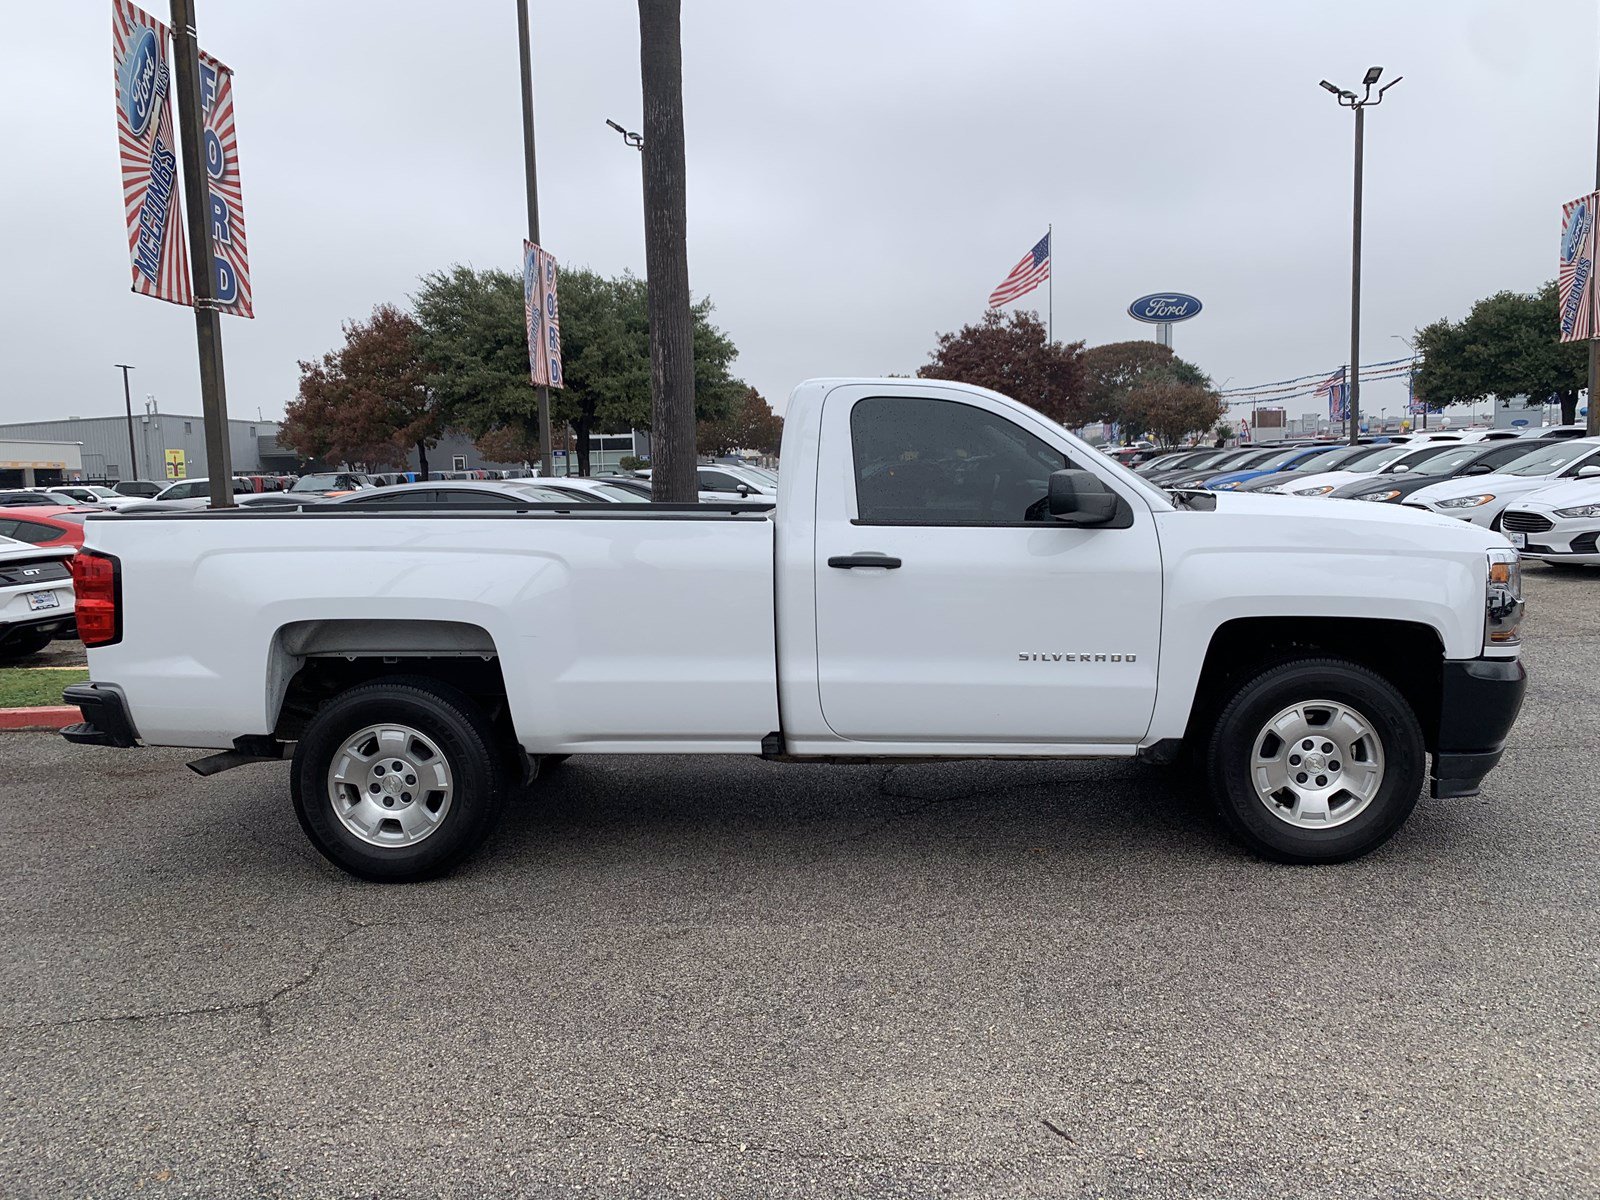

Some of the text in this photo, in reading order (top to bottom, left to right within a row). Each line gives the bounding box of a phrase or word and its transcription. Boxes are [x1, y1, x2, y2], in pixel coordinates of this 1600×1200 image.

[132, 53, 155, 118] Ford
[199, 62, 238, 304] FORD
[546, 260, 560, 383] FORD
[1145, 298, 1188, 316] Ford
[22, 568, 40, 576] GT
[1018, 652, 1137, 662] SILVERADO
